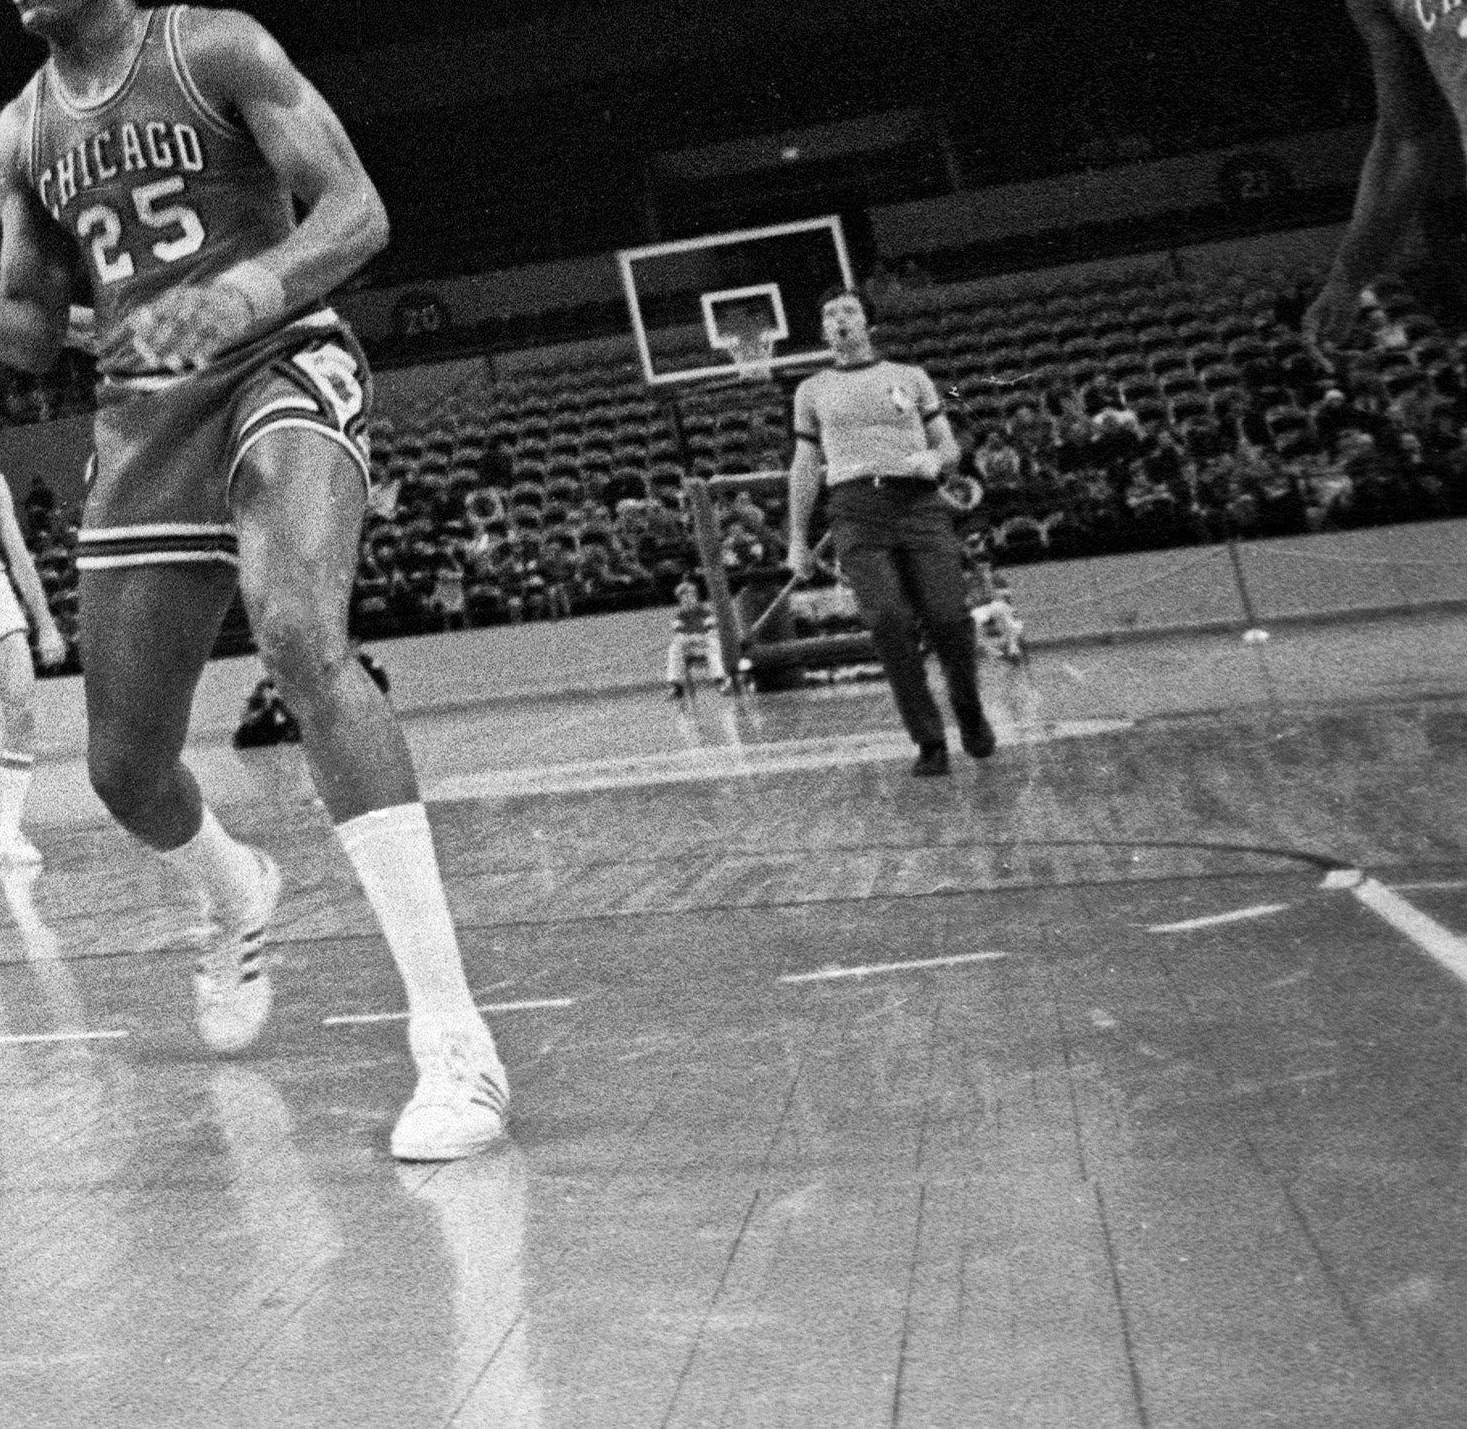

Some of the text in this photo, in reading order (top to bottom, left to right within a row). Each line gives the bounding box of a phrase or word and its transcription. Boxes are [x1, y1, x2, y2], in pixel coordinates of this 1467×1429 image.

[39, 121, 204, 221] CHICAGO
[76, 177, 205, 285] 25
[402, 303, 442, 336] 20
